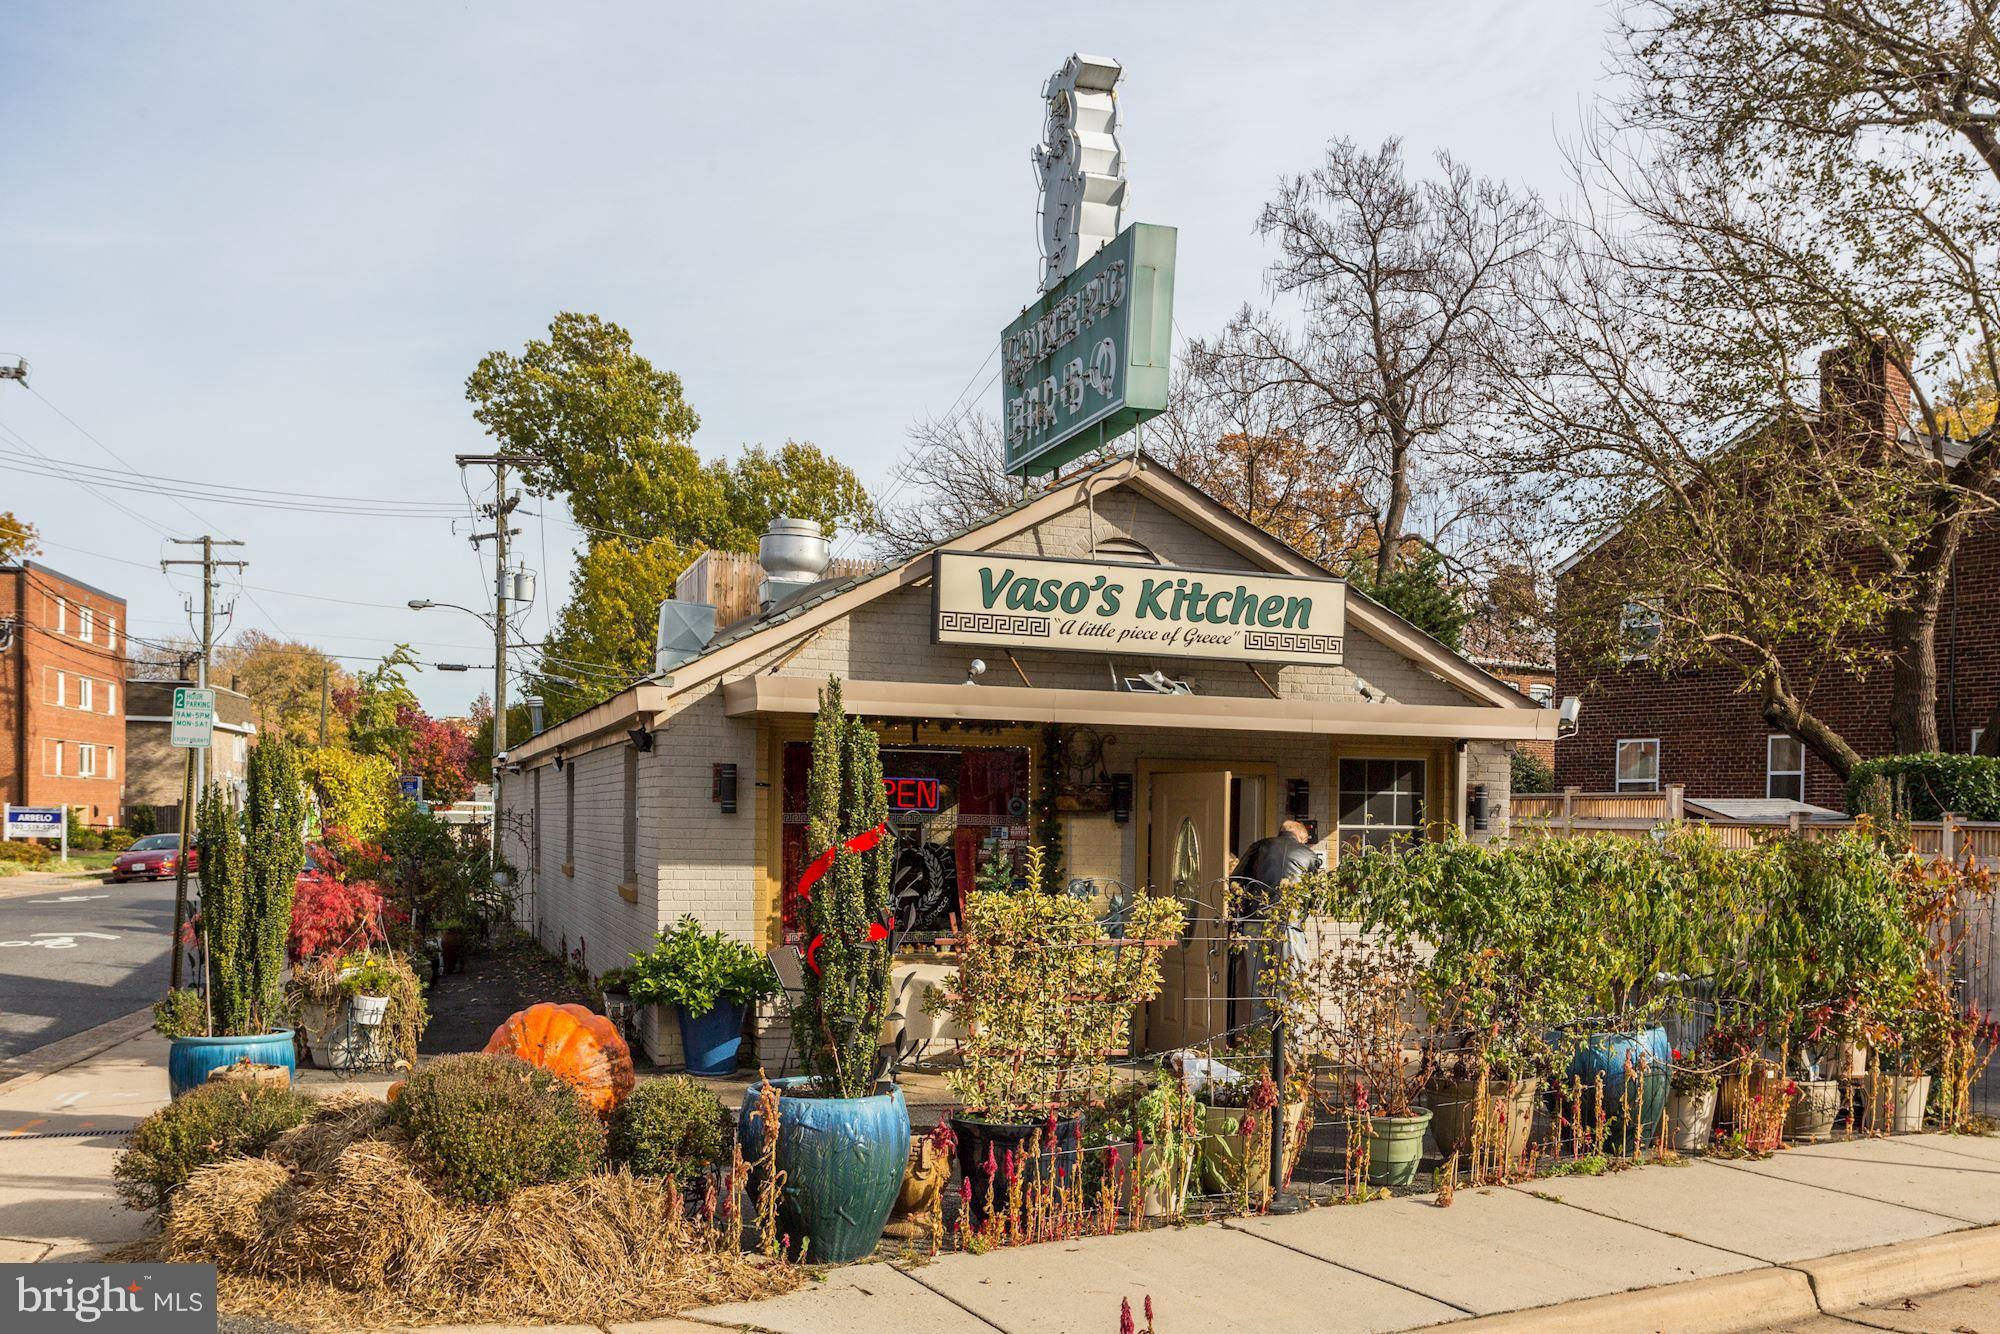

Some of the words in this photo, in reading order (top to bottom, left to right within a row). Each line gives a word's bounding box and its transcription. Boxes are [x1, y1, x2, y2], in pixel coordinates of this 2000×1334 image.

[979, 567, 1124, 616] Vaso's
[1135, 579, 1313, 629] Kitchen
[1077, 617, 1116, 638] little
[1116, 626, 1157, 643] piece
[1161, 627, 1183, 646] of
[176, 693, 184, 707] 2
[176, 711, 210, 719] 9AM-5PM
[176, 720, 208, 728] MON-SAT
[881, 779, 937, 808] PEN
[17, 813, 53, 822] ARBELO
